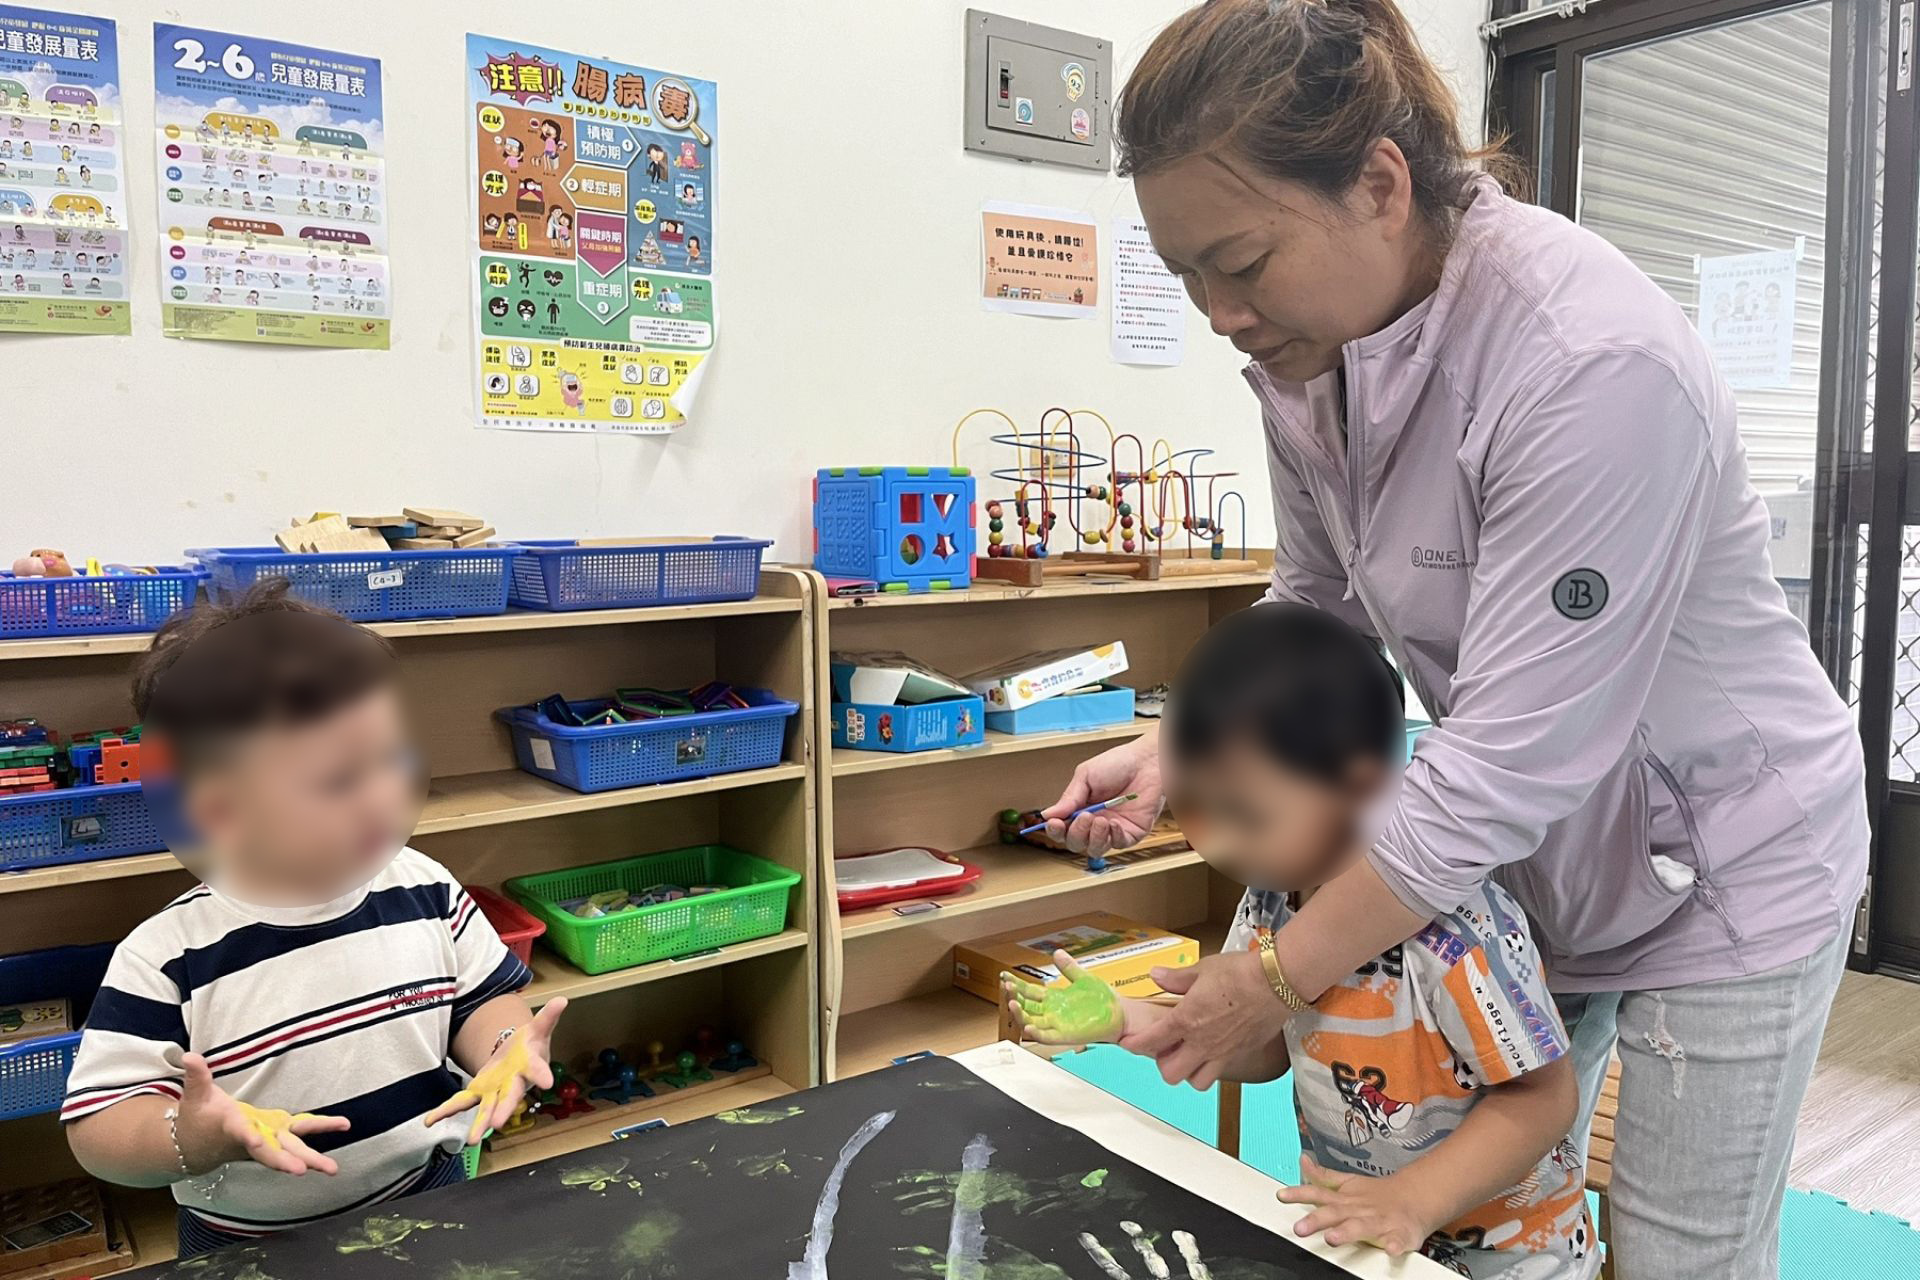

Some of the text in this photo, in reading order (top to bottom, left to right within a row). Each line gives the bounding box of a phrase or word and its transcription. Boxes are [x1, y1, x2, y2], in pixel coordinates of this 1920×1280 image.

[271, 63, 366, 98] 兒童發展量表
[572, 60, 690, 122] 腸病毒
[587, 125, 614, 142] 積極
[580, 141, 621, 160] 預防期
[485, 184, 504, 195] 方式
[583, 281, 622, 298] 重症期
[1424, 549, 1457, 562] ONE
